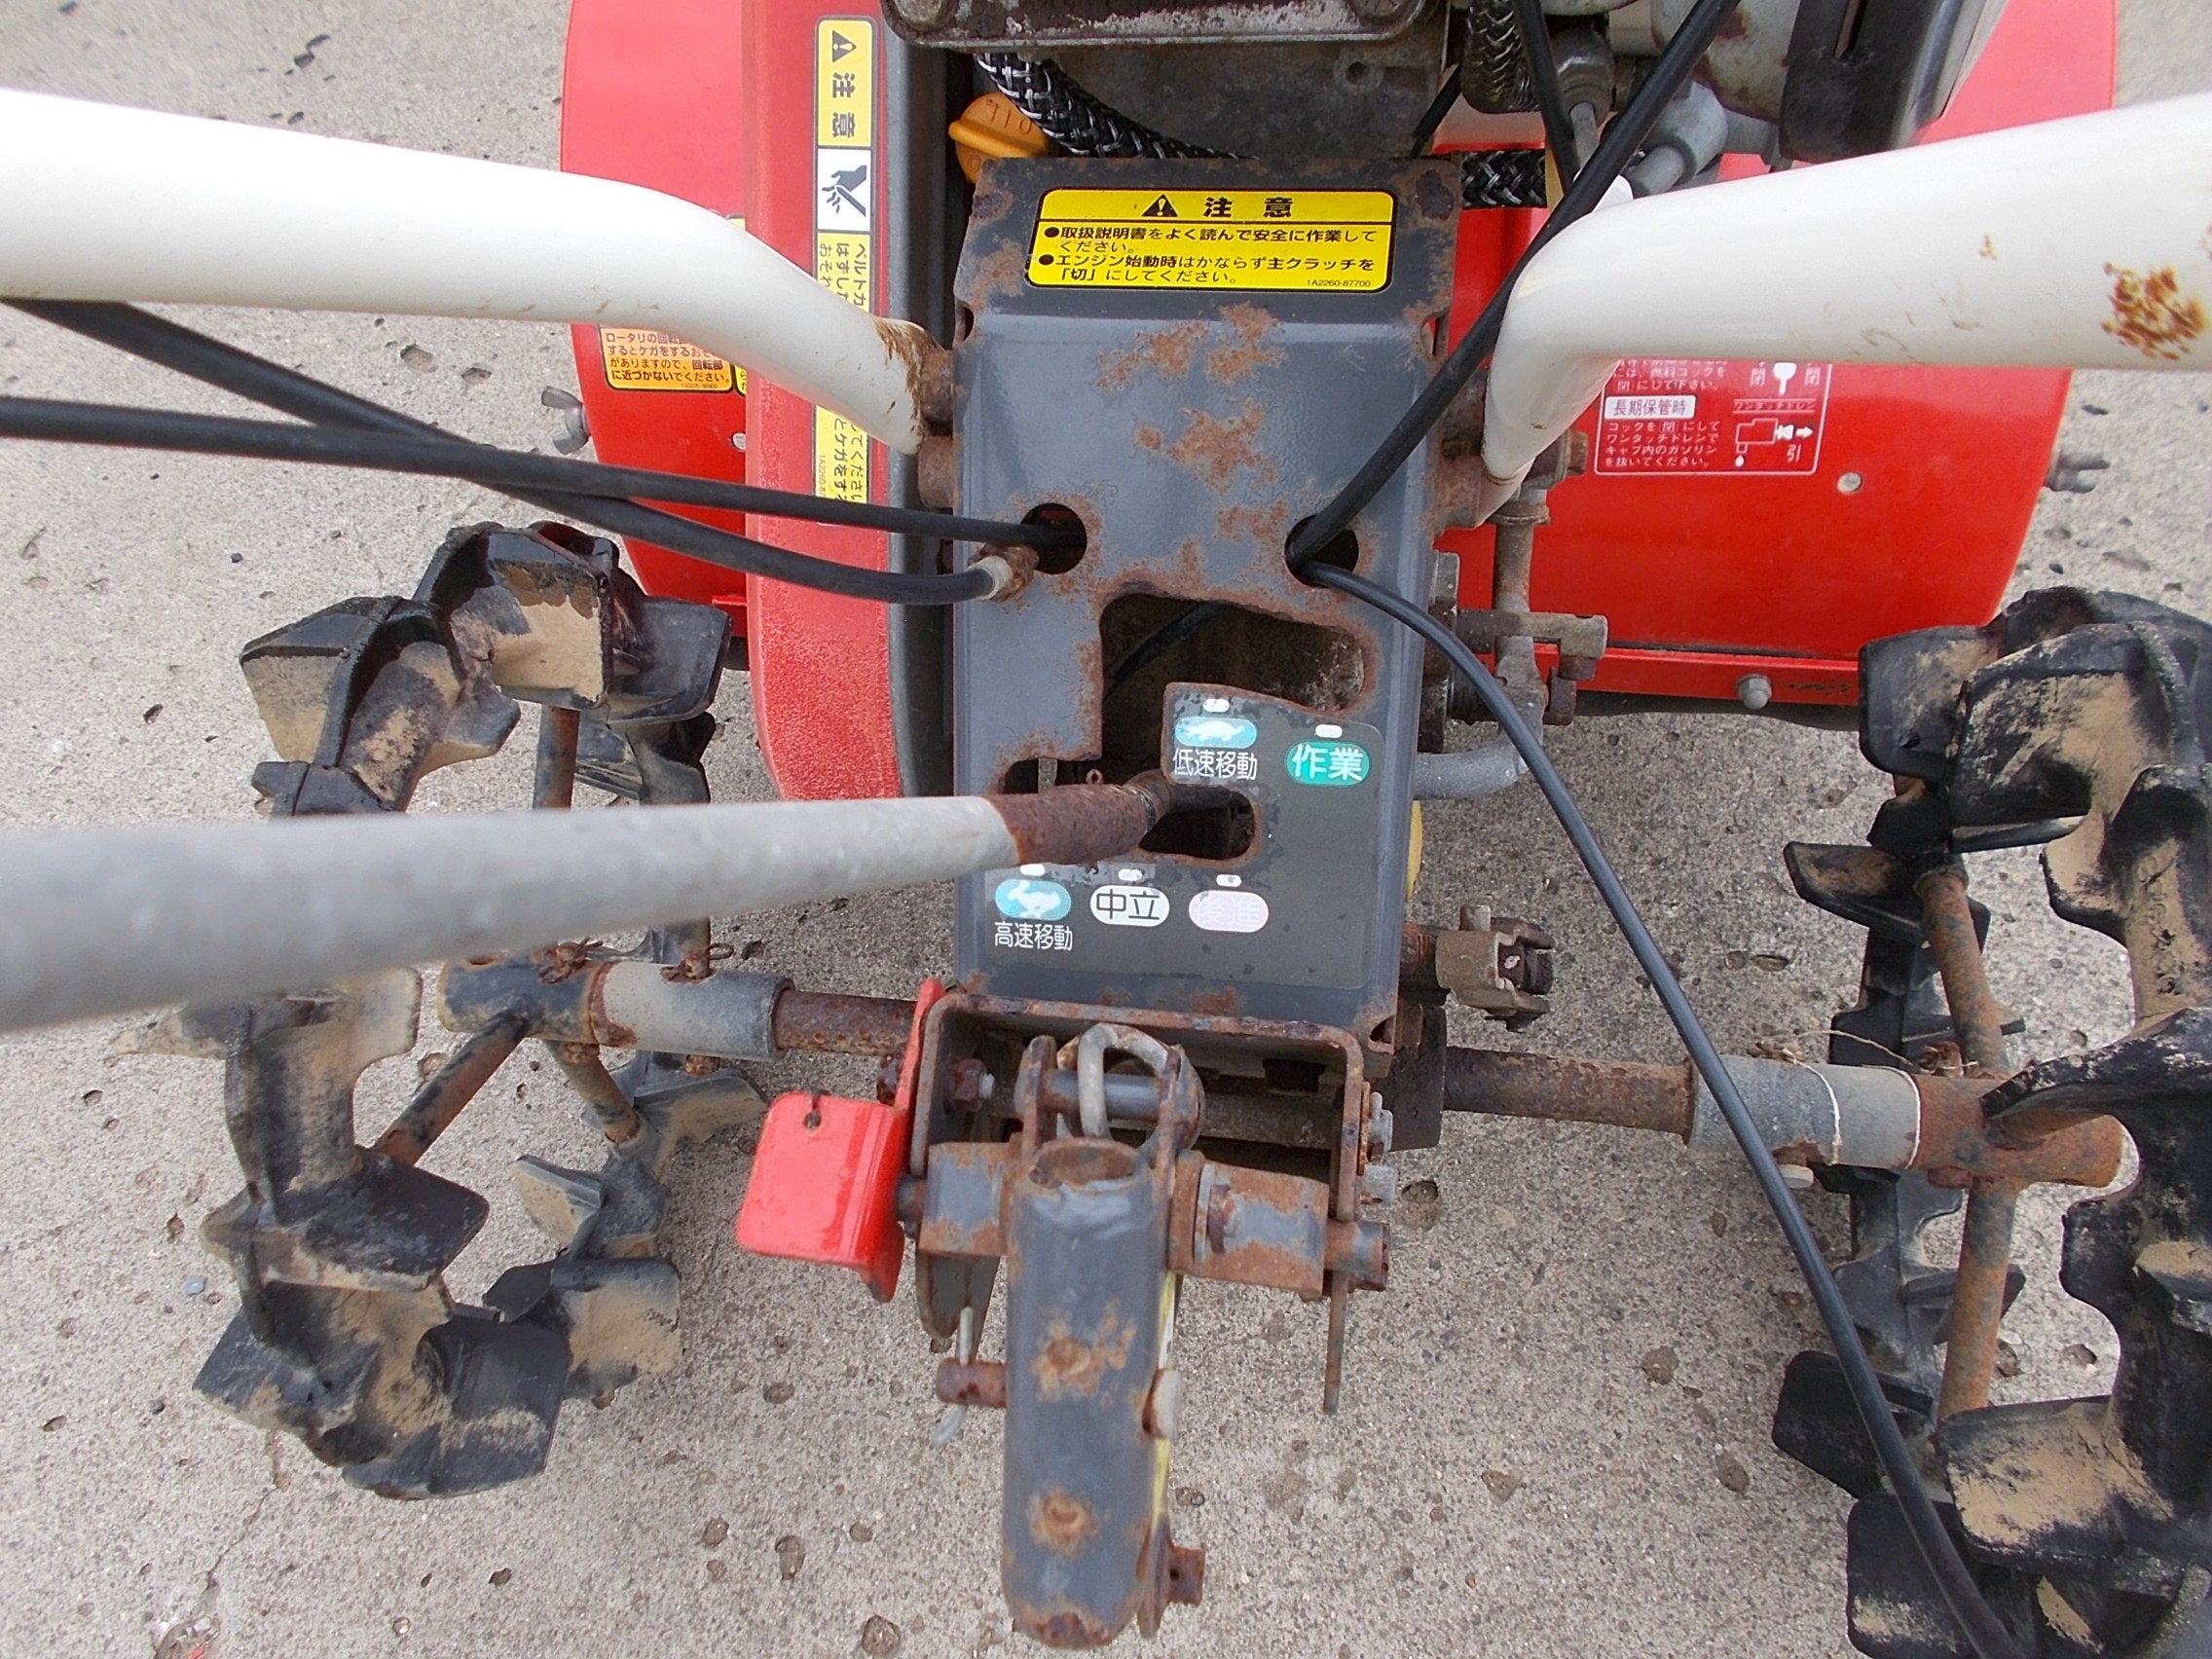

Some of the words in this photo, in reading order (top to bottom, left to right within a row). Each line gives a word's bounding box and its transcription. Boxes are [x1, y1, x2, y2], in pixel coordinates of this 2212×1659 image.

[831, 72, 857, 138] 注意
[1203, 197, 1293, 218] 注意
[1061, 225, 1377, 243] 取扱説明書をよく読んで安全に作業して
[1059, 240, 1135, 254] ください。
[1055, 254, 1375, 273] エンジン始動時はかならず主クラッチを
[611, 369, 730, 383] に近づかないでください。
[1613, 398, 1686, 416] 長期保管時
[1172, 748, 1258, 781] 低速移動
[1292, 744, 1364, 781] 作業
[1096, 888, 1161, 921] 中立
[994, 921, 1073, 951] 高速移動
